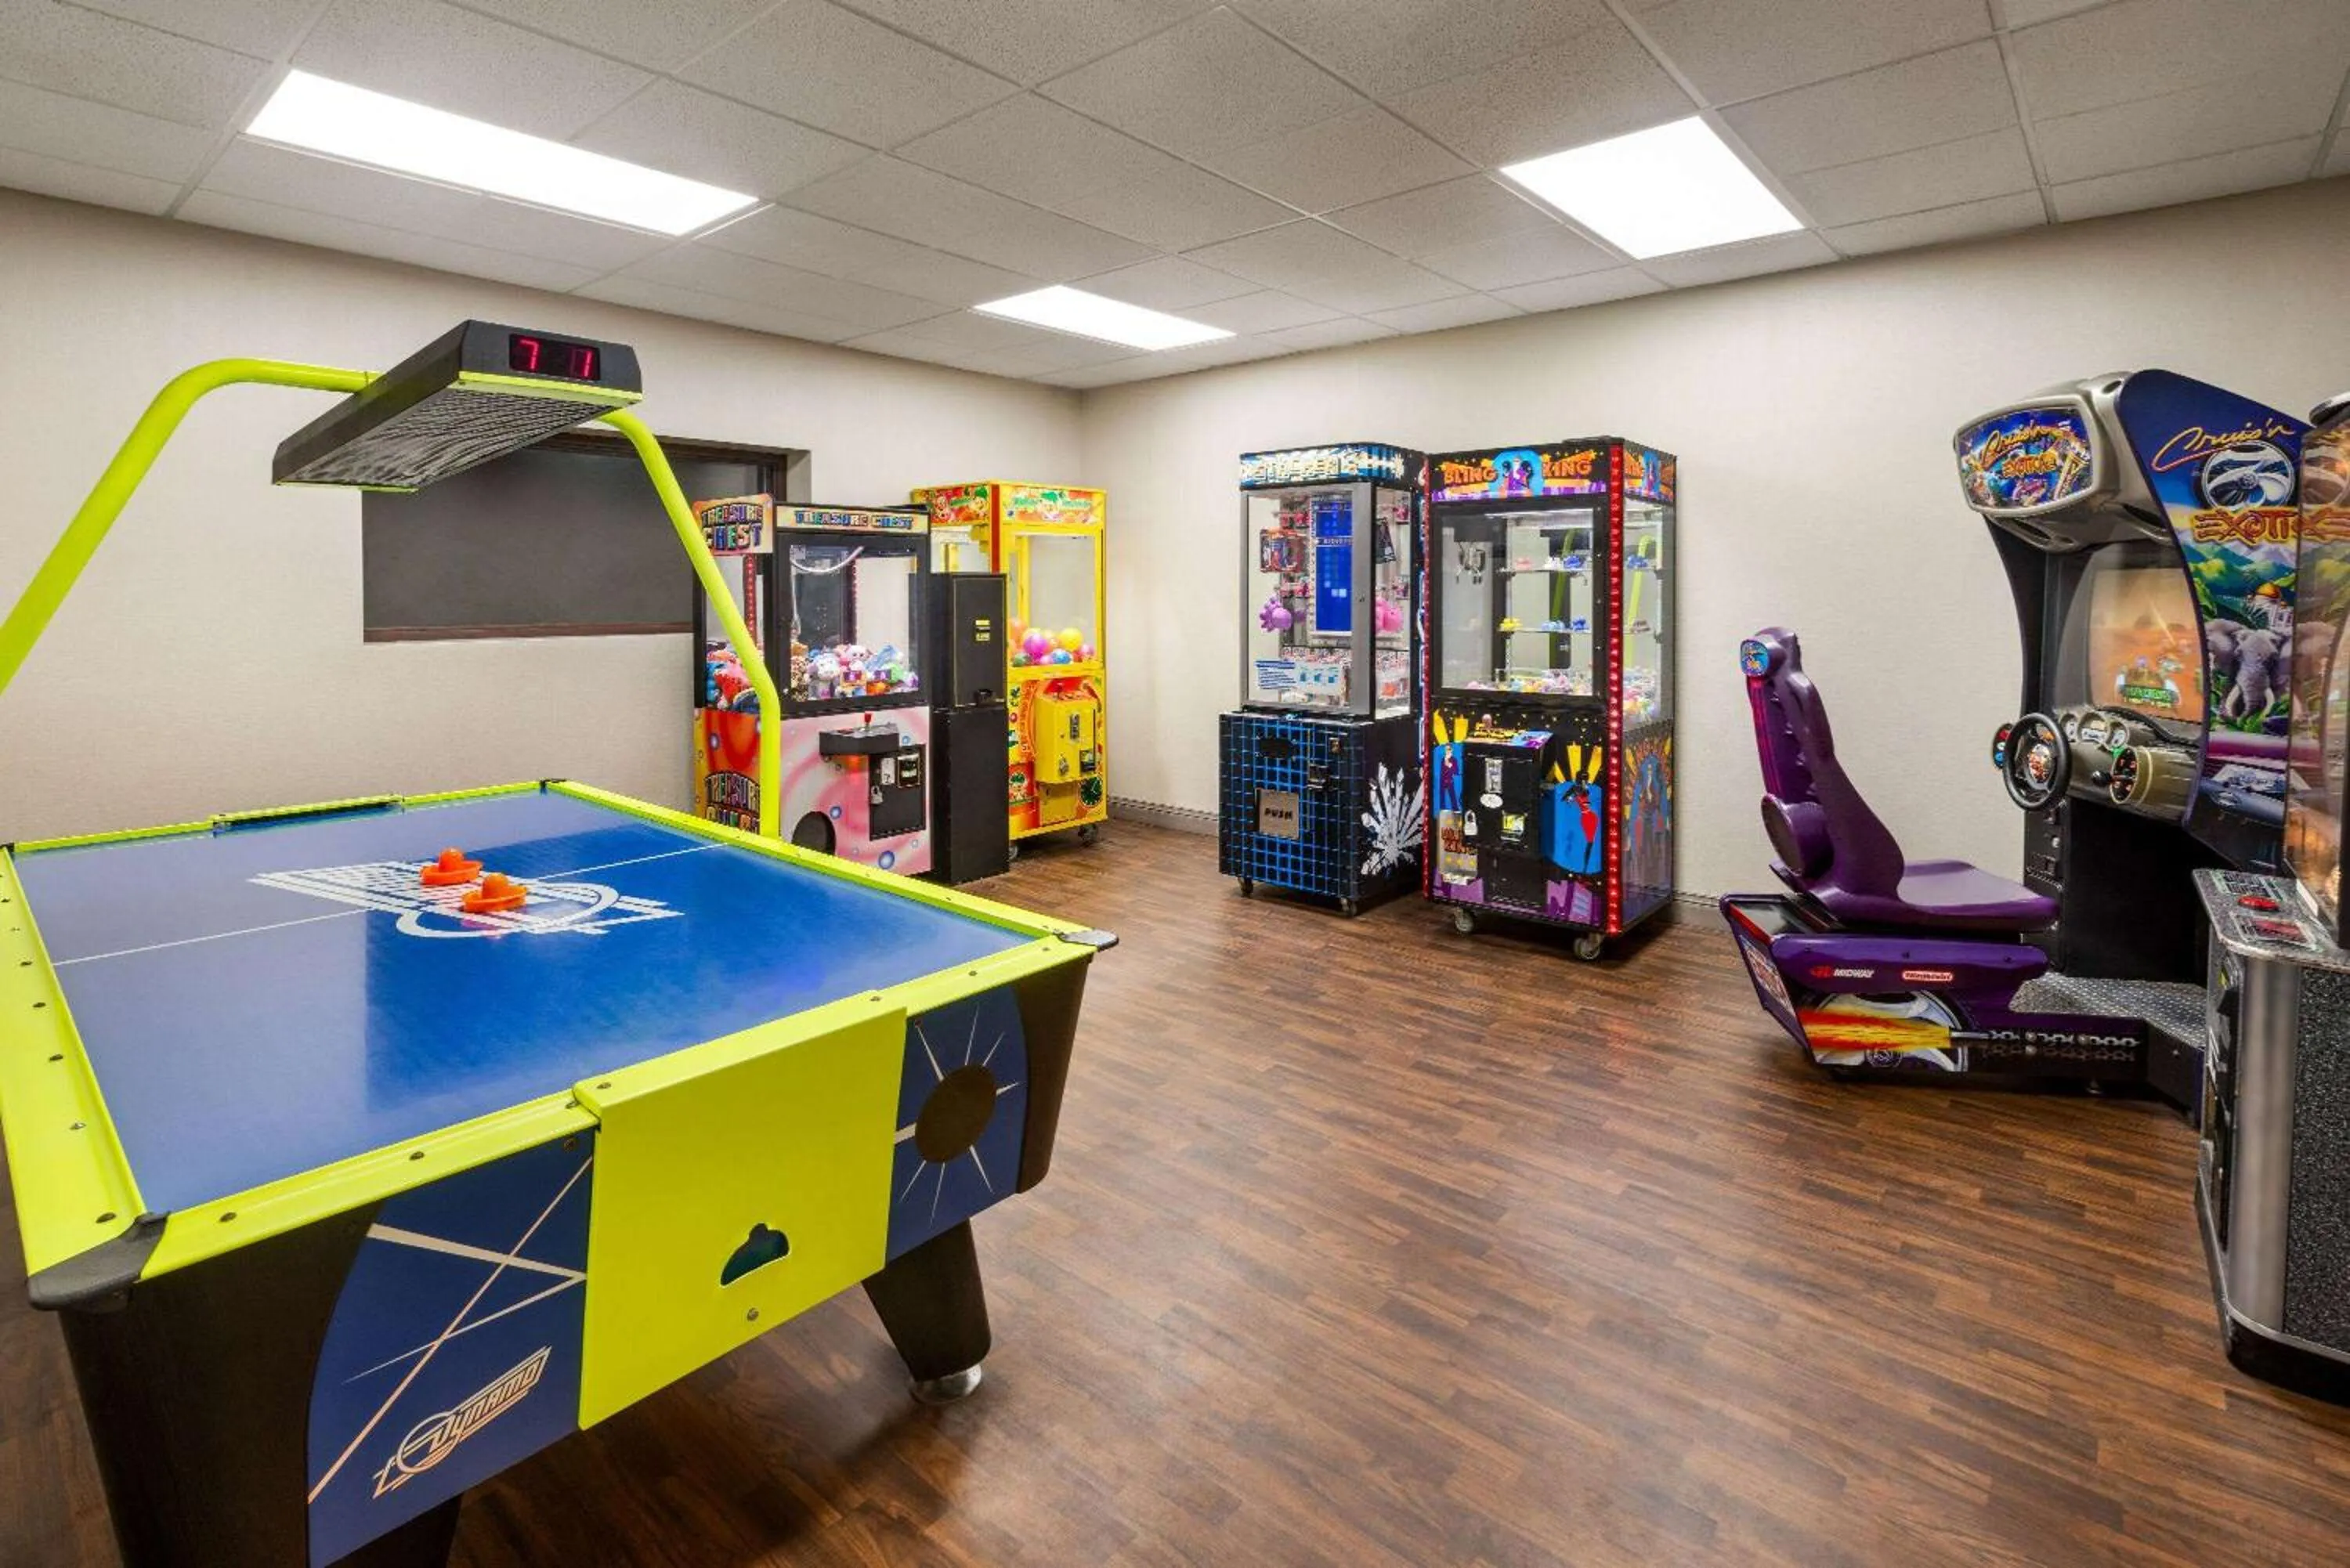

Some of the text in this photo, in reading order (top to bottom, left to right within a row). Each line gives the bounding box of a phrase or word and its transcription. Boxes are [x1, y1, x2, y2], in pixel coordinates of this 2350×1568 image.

[519, 338, 594, 377] 7 1
[2151, 418, 2295, 472] Cruis'n
[1444, 460, 1592, 485] BLING KING
[702, 503, 763, 527] TREASURE
[794, 510, 914, 529] TREASURE CHEST
[2194, 508, 2301, 544] EXOTI
[703, 522, 762, 550] CHEST
[1833, 969, 1875, 978] MIDWAY
